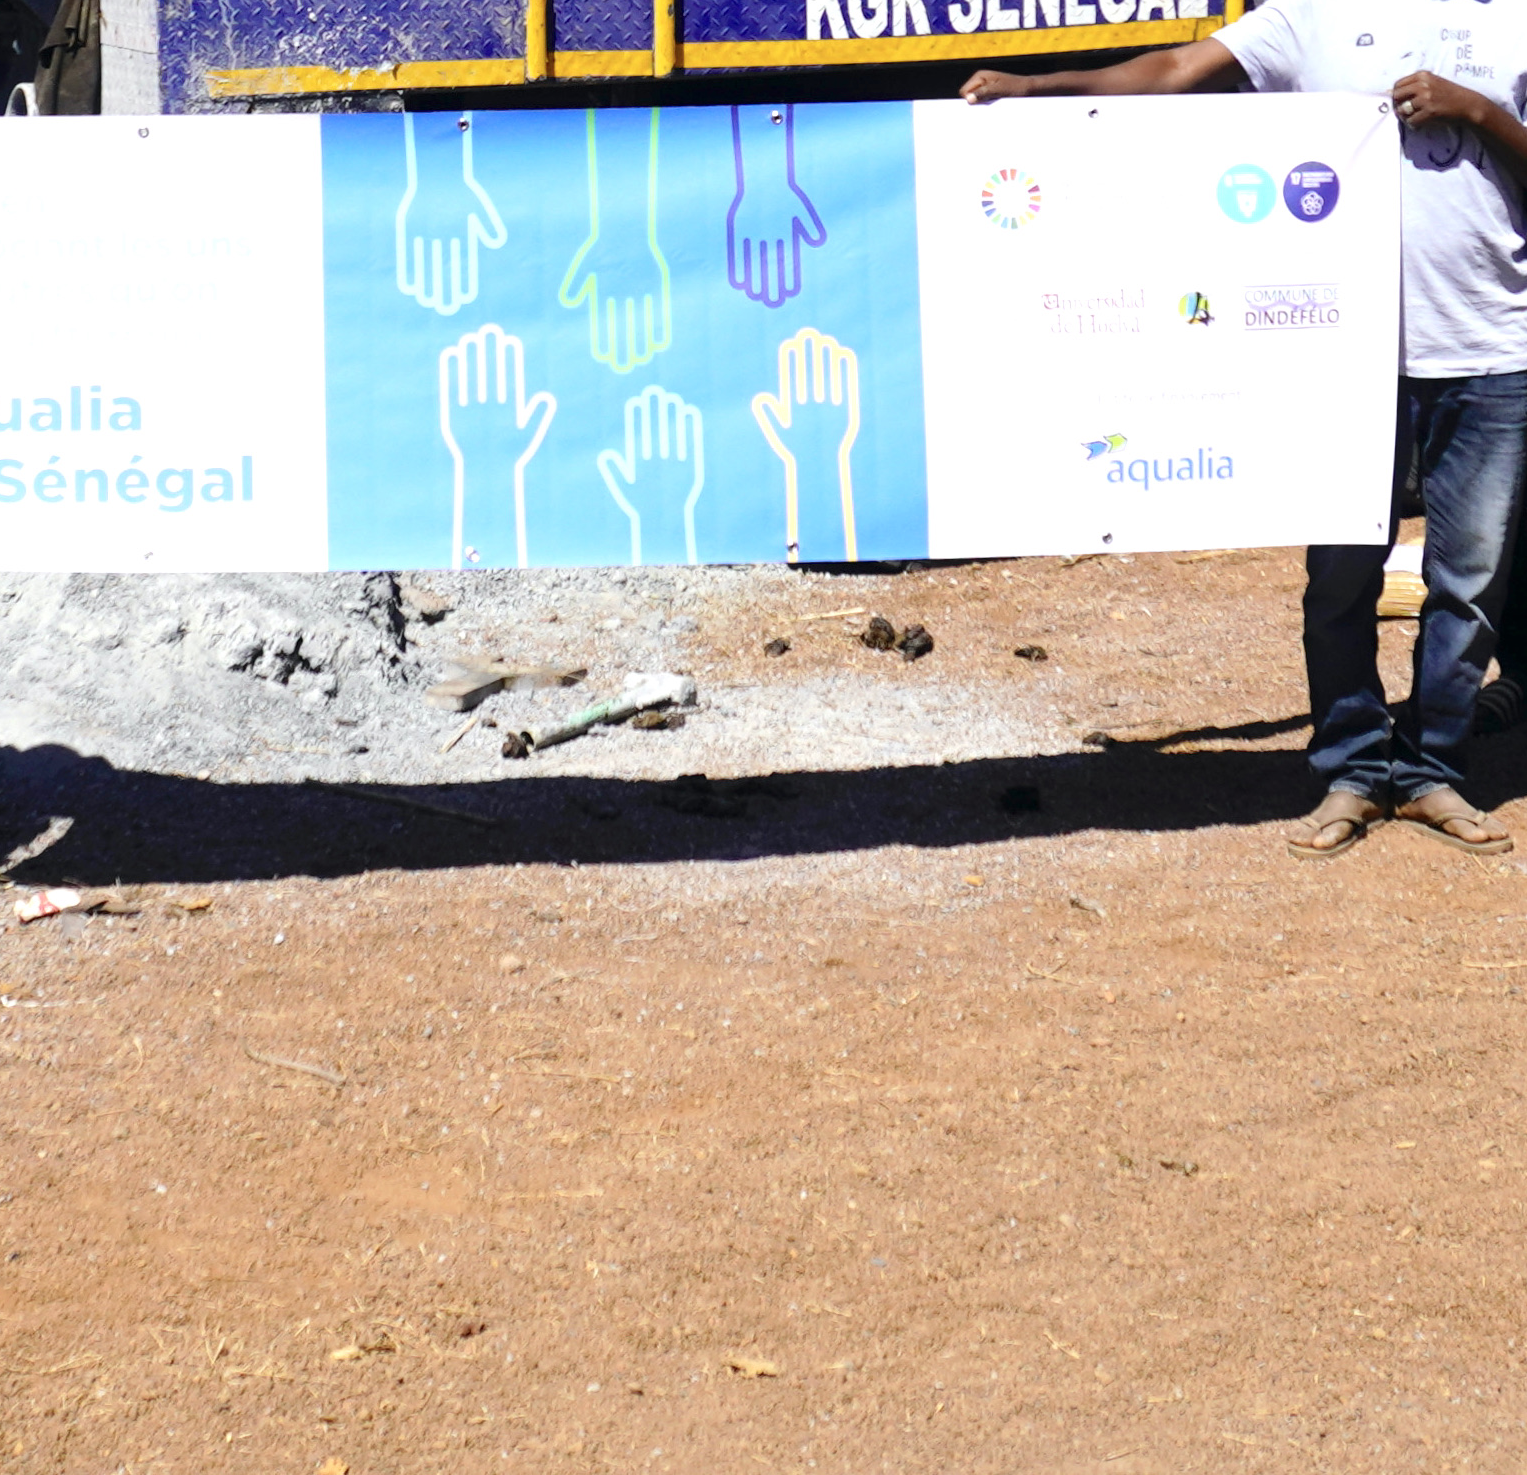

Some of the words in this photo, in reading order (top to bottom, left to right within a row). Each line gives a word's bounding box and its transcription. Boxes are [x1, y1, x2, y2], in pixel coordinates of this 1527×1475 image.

[1456, 44, 1473, 61] DE
[1244, 288, 1319, 304] COMMUNE
[1323, 287, 1341, 301] DE
[1244, 304, 1341, 327] DINDÉFÉLO
[1107, 447, 1234, 491] aqualia
